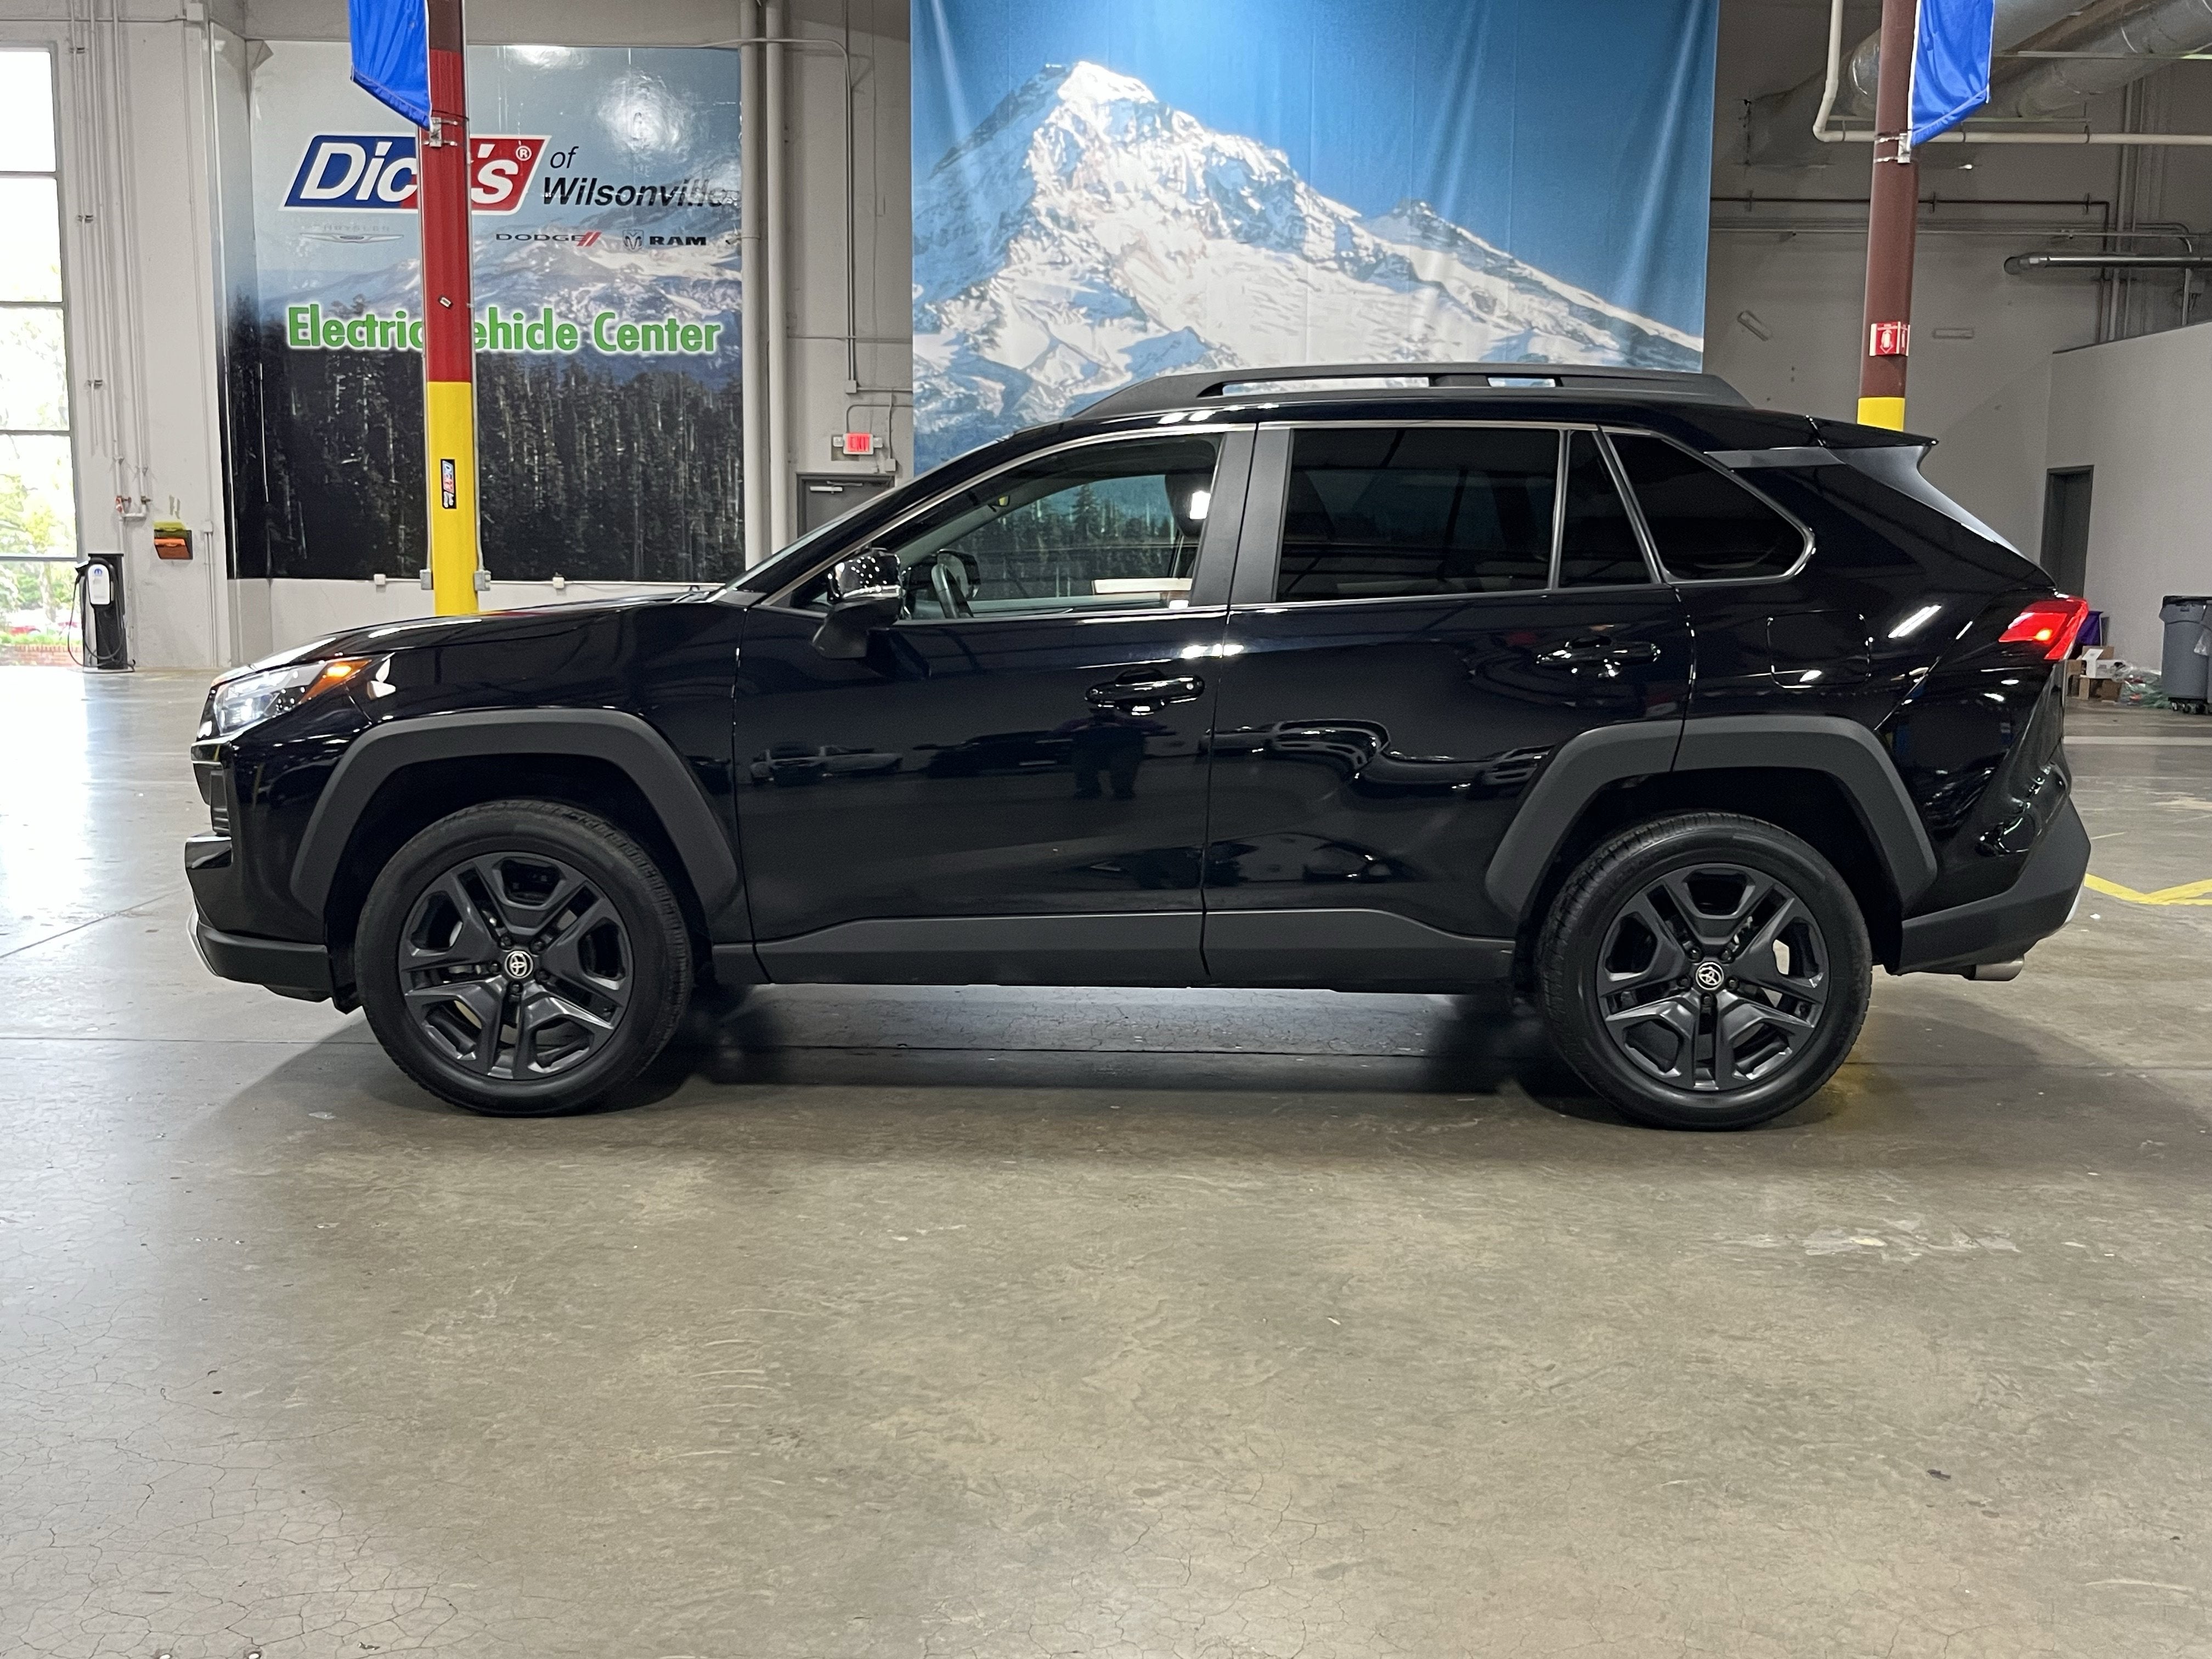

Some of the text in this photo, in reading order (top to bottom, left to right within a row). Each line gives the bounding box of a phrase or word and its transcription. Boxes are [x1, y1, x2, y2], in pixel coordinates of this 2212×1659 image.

[550, 146, 579, 168] of
[495, 233, 586, 241] DODGE
[649, 235, 707, 246] RAM
[289, 304, 721, 352] Electric ehicle Center
